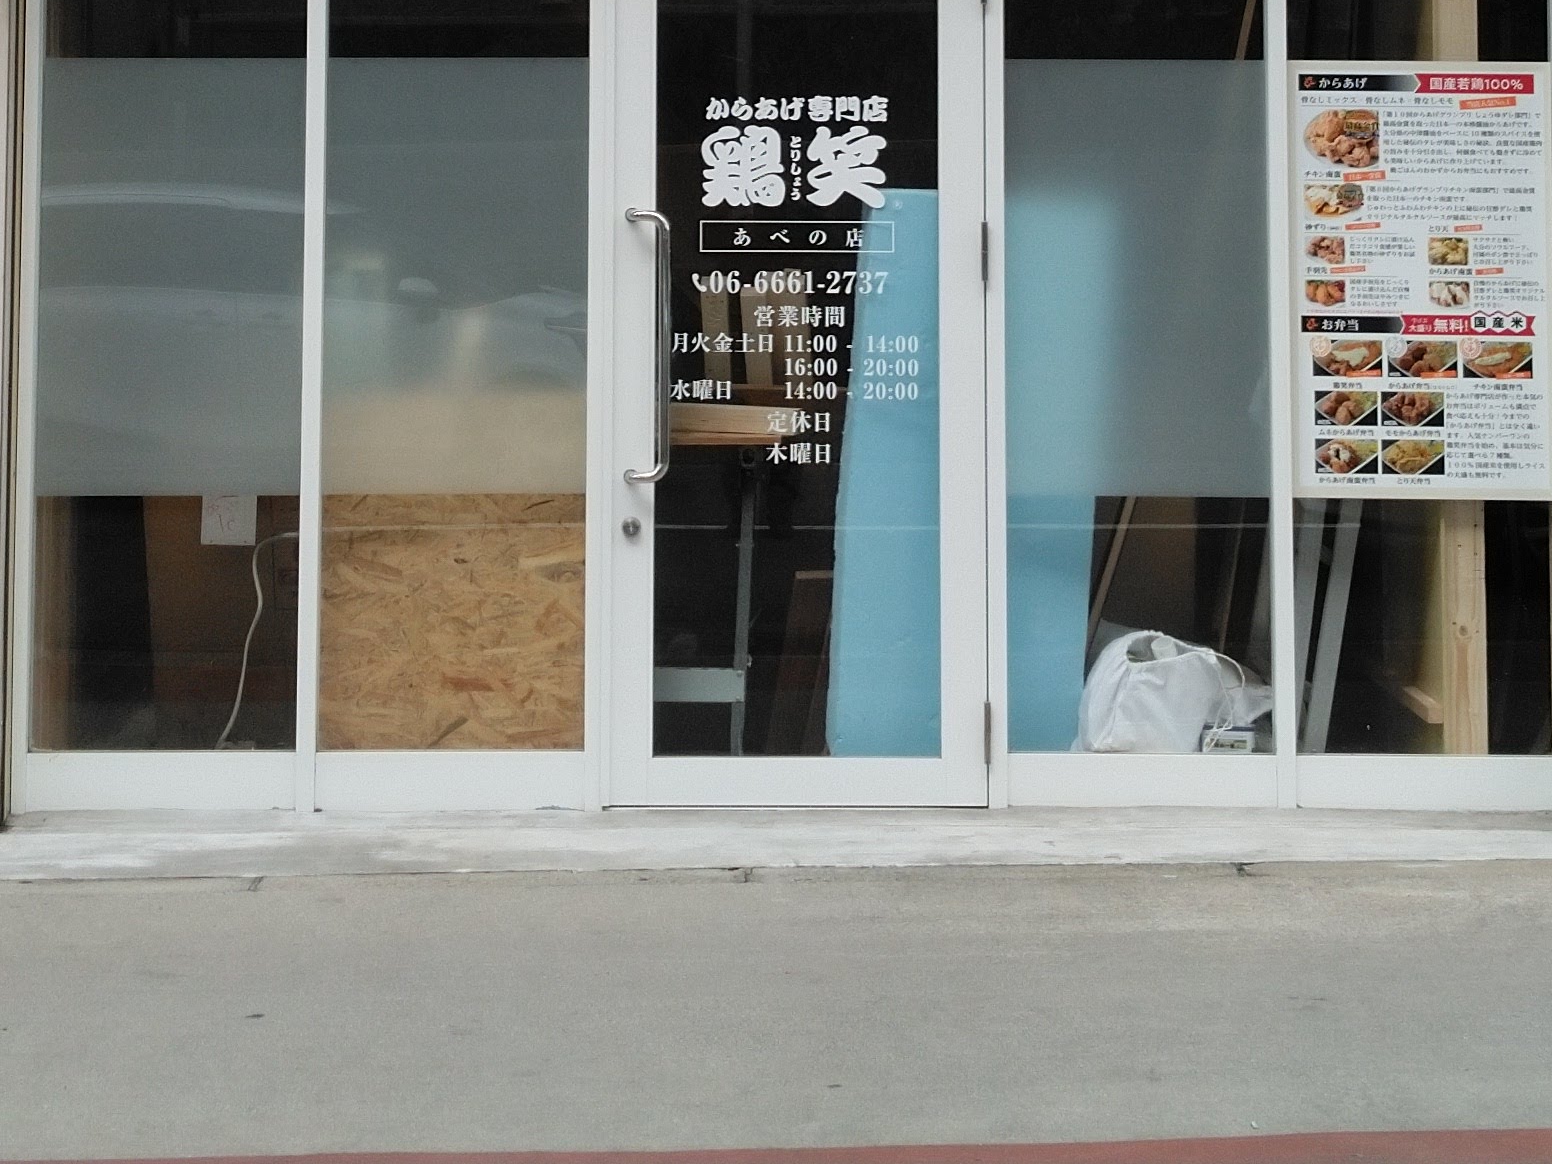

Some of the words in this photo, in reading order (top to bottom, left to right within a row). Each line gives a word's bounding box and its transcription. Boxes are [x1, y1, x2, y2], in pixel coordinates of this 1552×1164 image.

[1318, 76, 1368, 90] からあげ
[1429, 76, 1525, 91] 国産若鶏100%
[705, 96, 890, 123] からあげ専門店
[701, 125, 887, 209] 鶏笑
[790, 136, 801, 202] とりしょう
[733, 228, 865, 248] あべの店
[709, 270, 890, 296] 06-6661-2737
[753, 306, 846, 329] 営業時間
[1321, 319, 1359, 331] お弁当
[1474, 317, 1524, 329] 国産米
[671, 332, 774, 354] 月火金土日
[784, 334, 838, 354] 11:00
[866, 335, 920, 354] 14:00
[784, 358, 838, 377] 16:00
[863, 358, 920, 377] 20:00
[670, 379, 733, 401] 水曜日
[784, 381, 838, 400] 14:00
[863, 381, 920, 400] 20:00
[767, 411, 832, 433] 定休日
[766, 442, 832, 465] 木曜日
